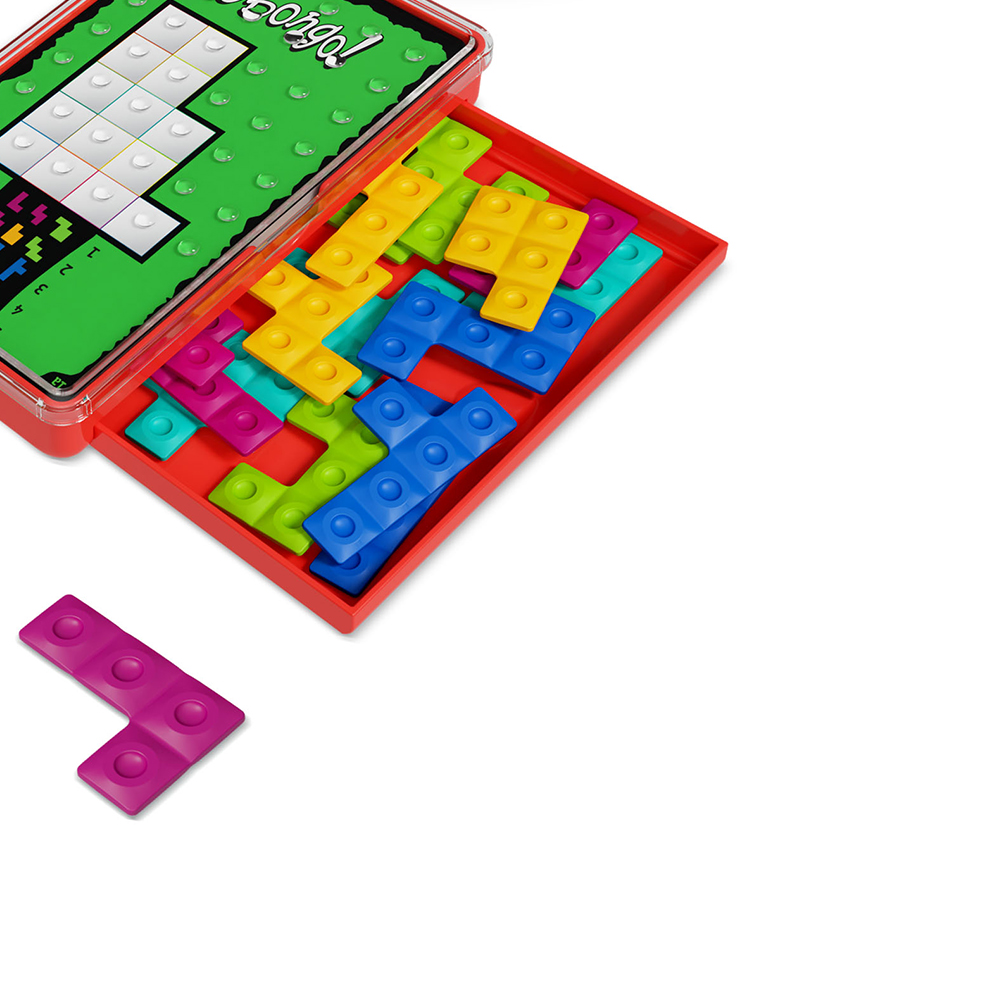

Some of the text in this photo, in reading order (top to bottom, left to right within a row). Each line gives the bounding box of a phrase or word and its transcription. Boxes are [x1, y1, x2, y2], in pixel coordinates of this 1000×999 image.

[87, 246, 100, 258] 1
[59, 263, 73, 276] 2
[34, 283, 48, 295] 3
[11, 304, 23, 315] 4
